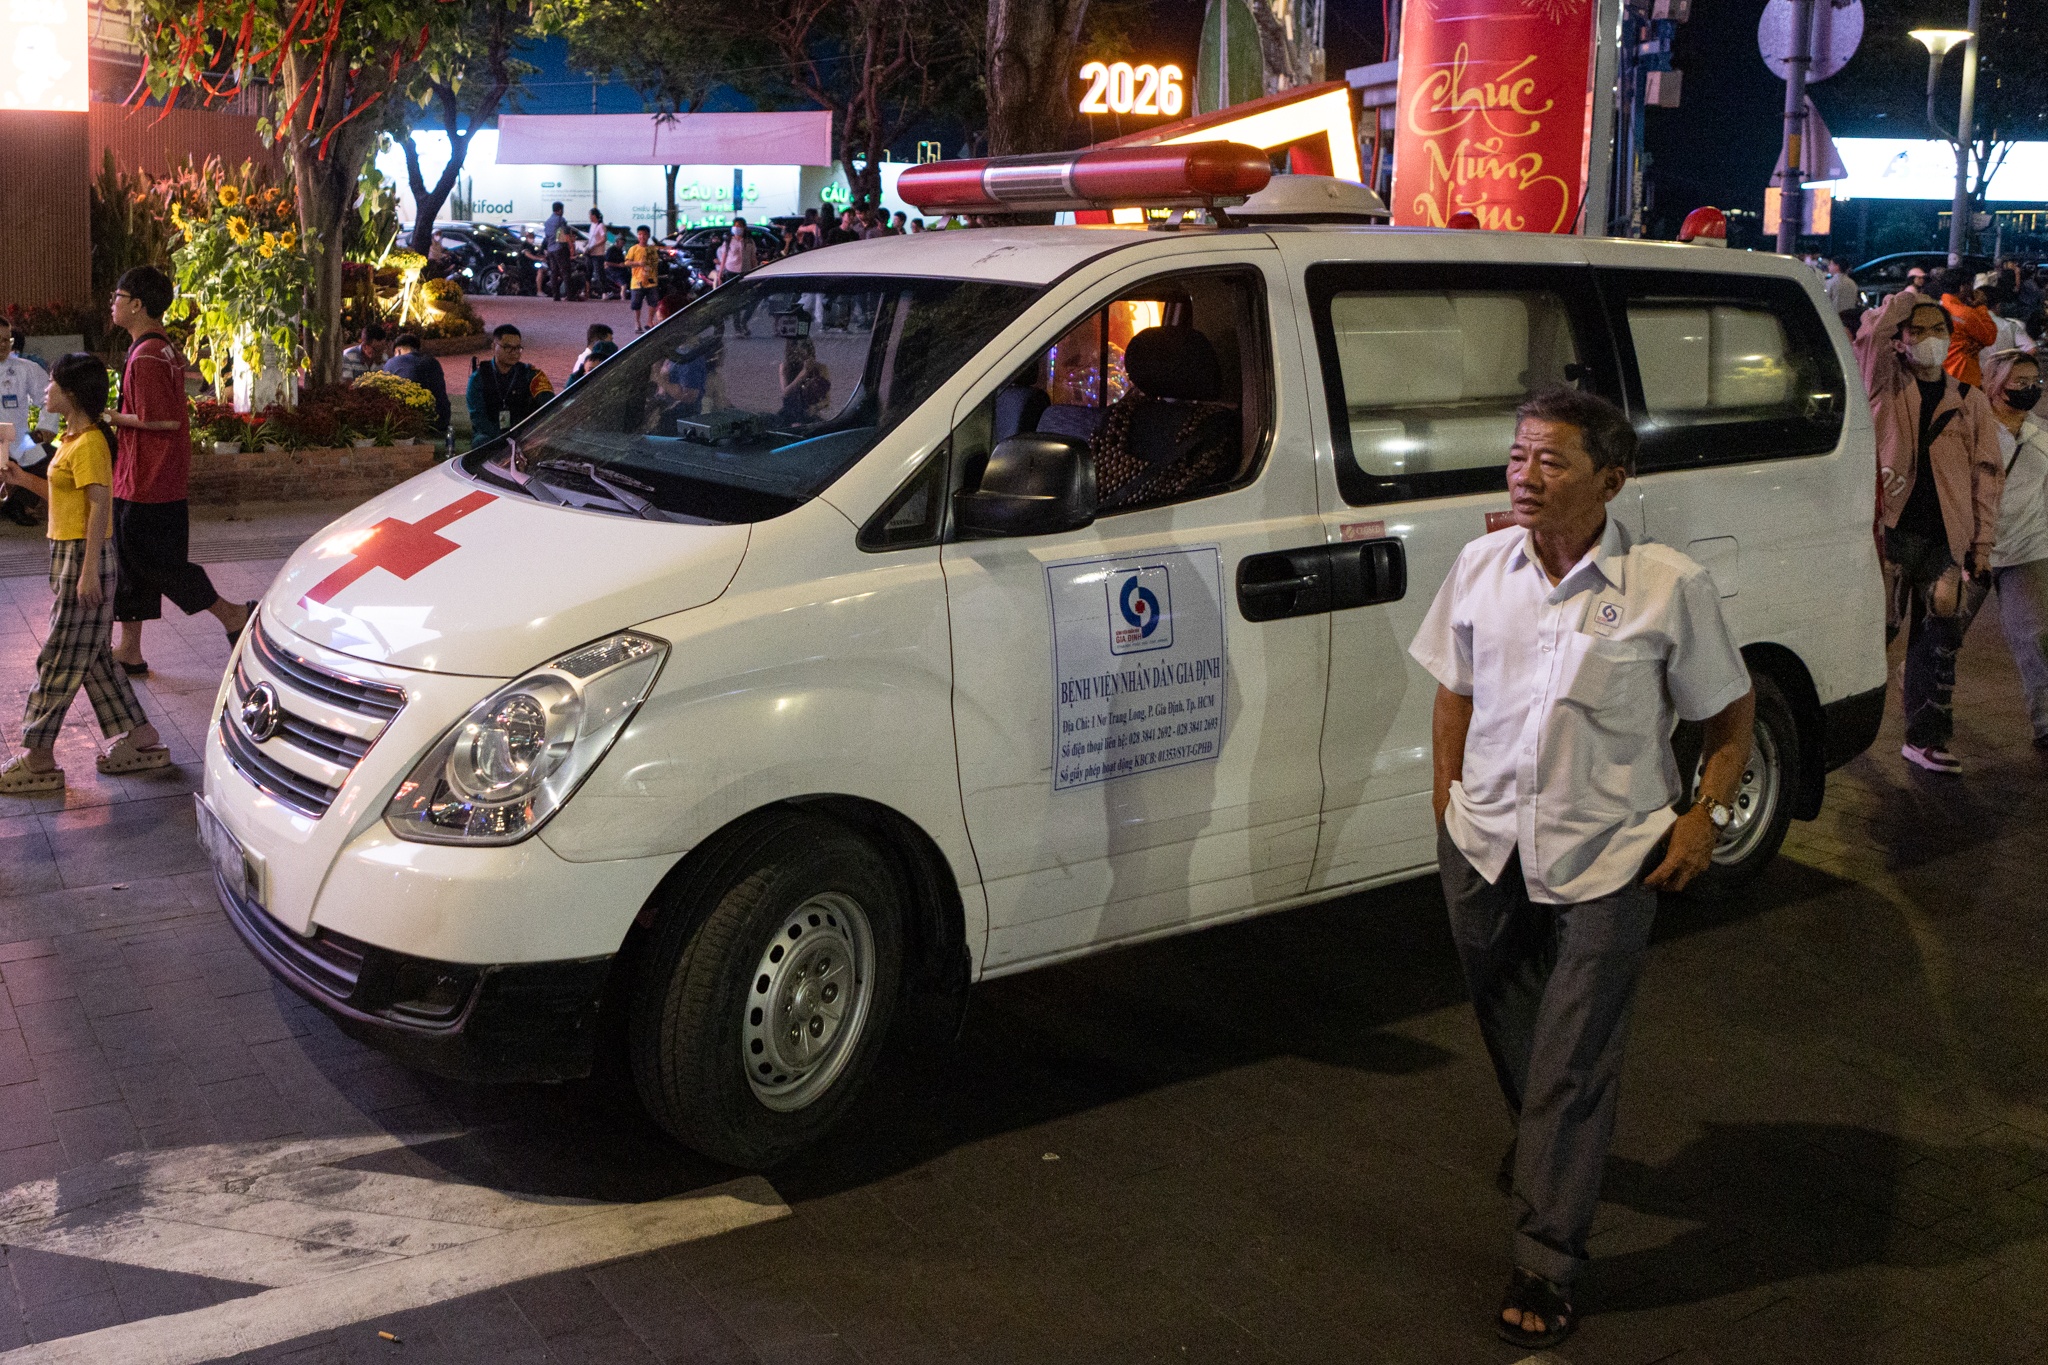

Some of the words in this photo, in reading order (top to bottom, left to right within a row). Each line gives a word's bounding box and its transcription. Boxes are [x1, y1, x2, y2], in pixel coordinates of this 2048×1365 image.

[1079, 61, 1183, 116] 2026
[1407, 42, 1554, 137] Chúc
[1423, 137, 1569, 233] Mừng
[472, 199, 513, 214] tifood
[1116, 635, 1127, 643] GIA
[1061, 676, 1091, 709] BỆNH
[1093, 671, 1118, 702] VIỆN
[1119, 662, 1151, 694] NHÂN
[1153, 658, 1175, 688] DÂN
[1176, 663, 1195, 684] GIA
[1196, 656, 1221, 686] ĐỊNH
[1108, 711, 1127, 726] Trang
[1148, 704, 1154, 717] P.
[1155, 702, 1167, 716] Gia
[1197, 694, 1215, 709] HCM
[1061, 740, 1070, 758] Số
[1128, 730, 1140, 745] 028
[1176, 722, 1188, 737] 028
[1134, 750, 1157, 767] KBCB:
